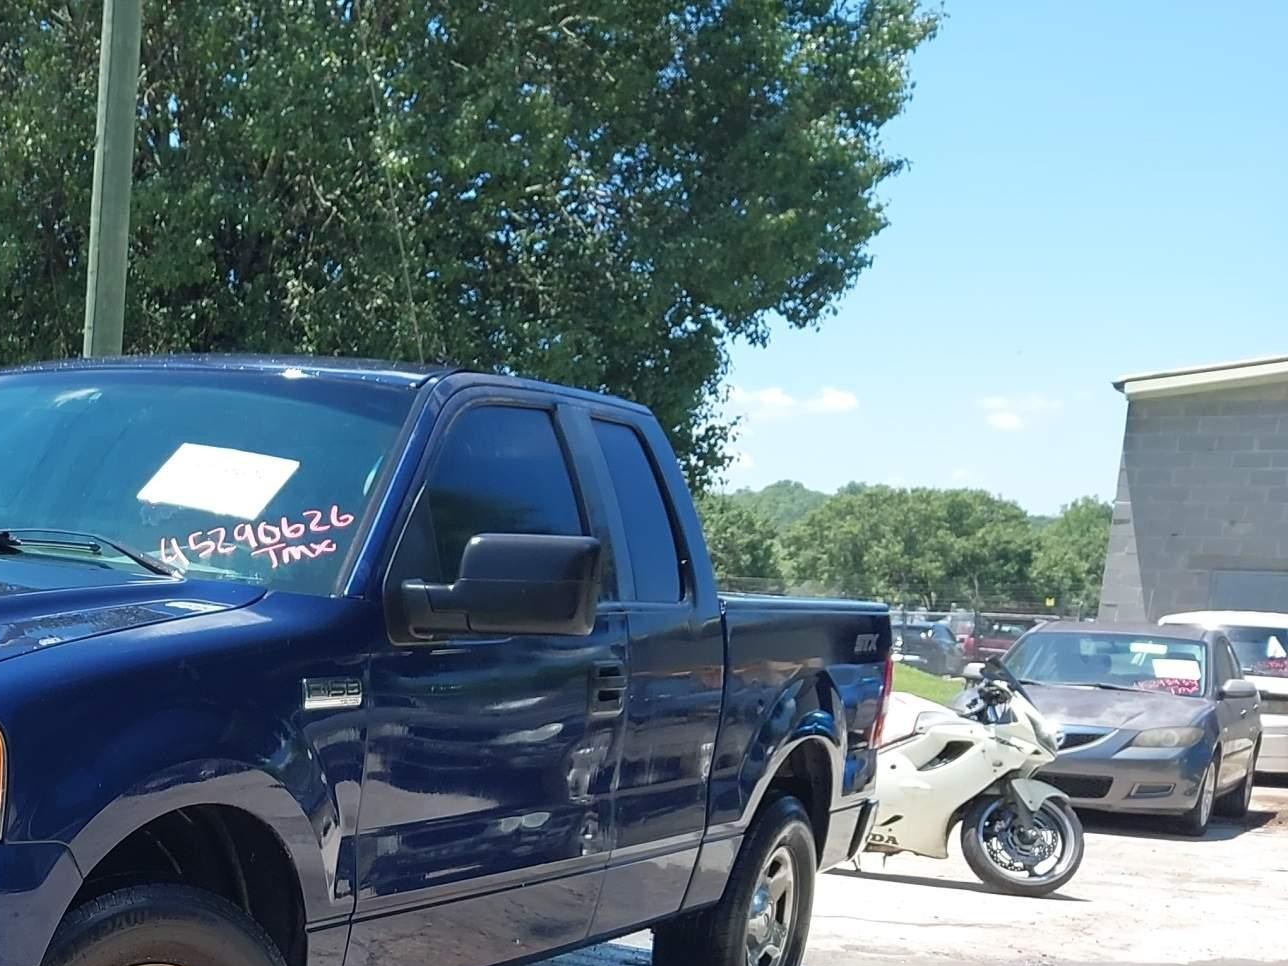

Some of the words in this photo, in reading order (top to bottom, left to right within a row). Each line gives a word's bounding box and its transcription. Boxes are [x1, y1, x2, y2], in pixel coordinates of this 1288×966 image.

[160, 505, 355, 565] 45290626
[854, 633, 880, 652] STX
[865, 832, 899, 845] DA
